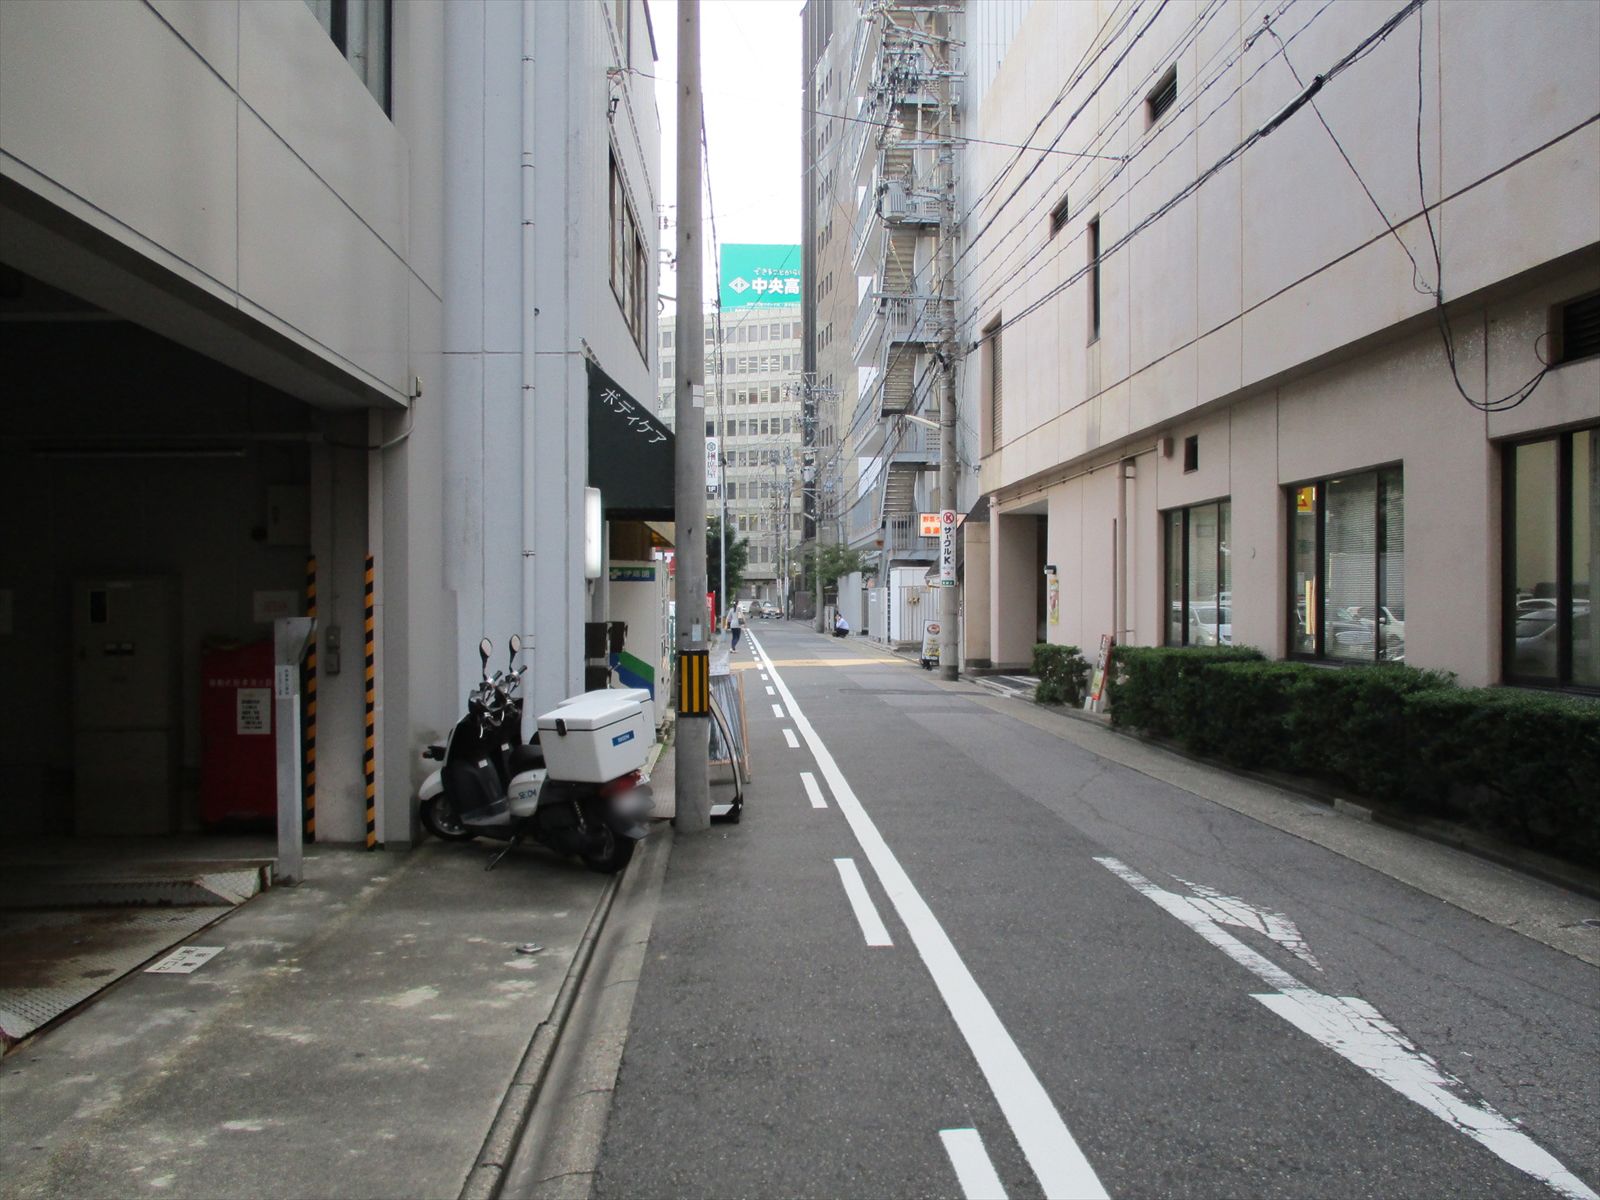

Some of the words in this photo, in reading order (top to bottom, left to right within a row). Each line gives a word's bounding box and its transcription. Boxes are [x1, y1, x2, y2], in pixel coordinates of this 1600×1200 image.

[600, 388, 667, 443] ボディケア
[943, 527, 952, 564] サークルK
